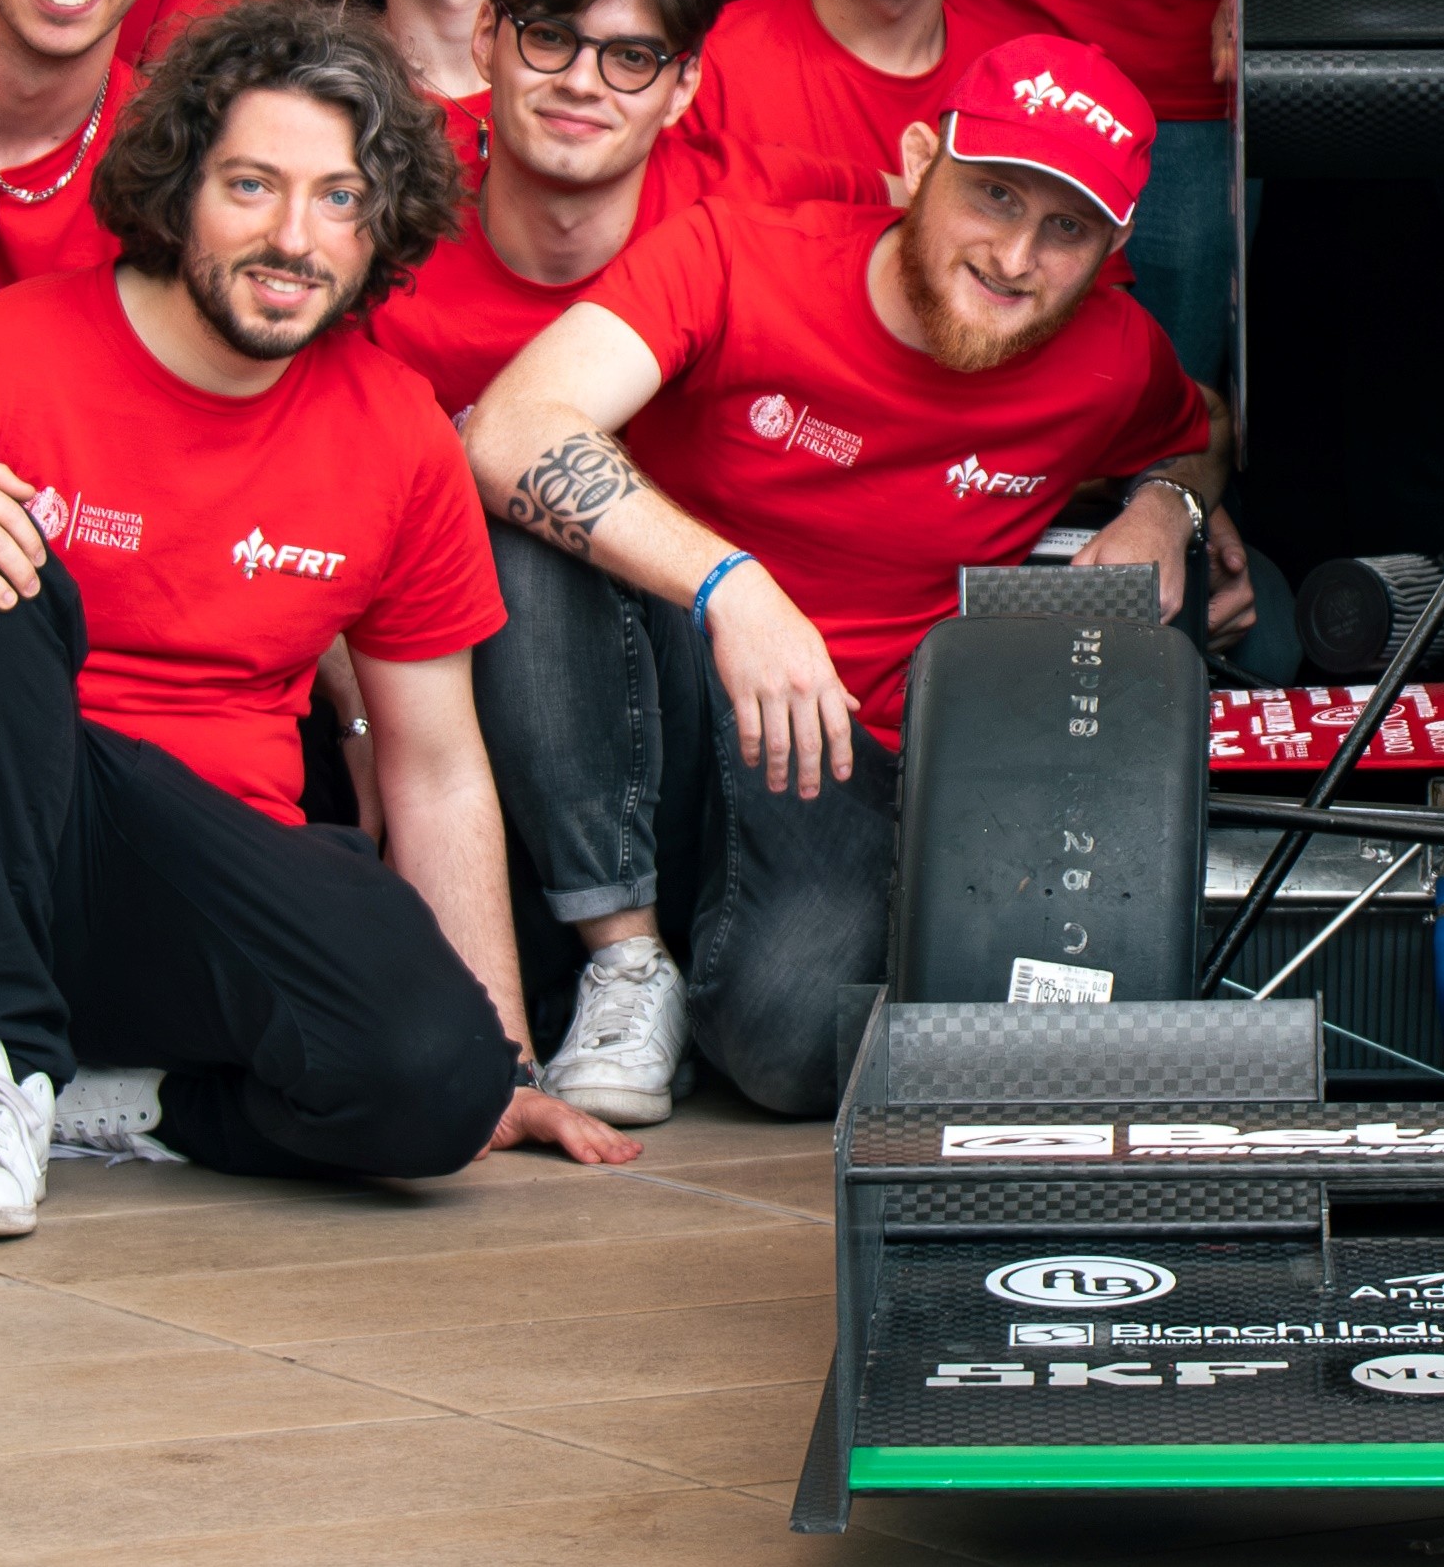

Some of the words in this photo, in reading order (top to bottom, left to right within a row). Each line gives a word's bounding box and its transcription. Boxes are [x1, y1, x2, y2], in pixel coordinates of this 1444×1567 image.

[1062, 91, 1133, 144] FRT
[797, 433, 856, 467] FIRENZE
[802, 425, 832, 443] DEGLI
[833, 436, 860, 455] STUDI
[986, 472, 1046, 494] FRT
[79, 515, 110, 530] DEGLI
[111, 522, 142, 536] STUDI
[76, 527, 140, 551] FIRENZE
[276, 545, 346, 577] FRT
[1112, 1322, 1324, 1338] Bianchi
[1112, 1337, 1202, 1345] PREMIUM
[1207, 1337, 1300, 1345] ORIGINAL
[925, 1362, 1289, 1385] SKF
